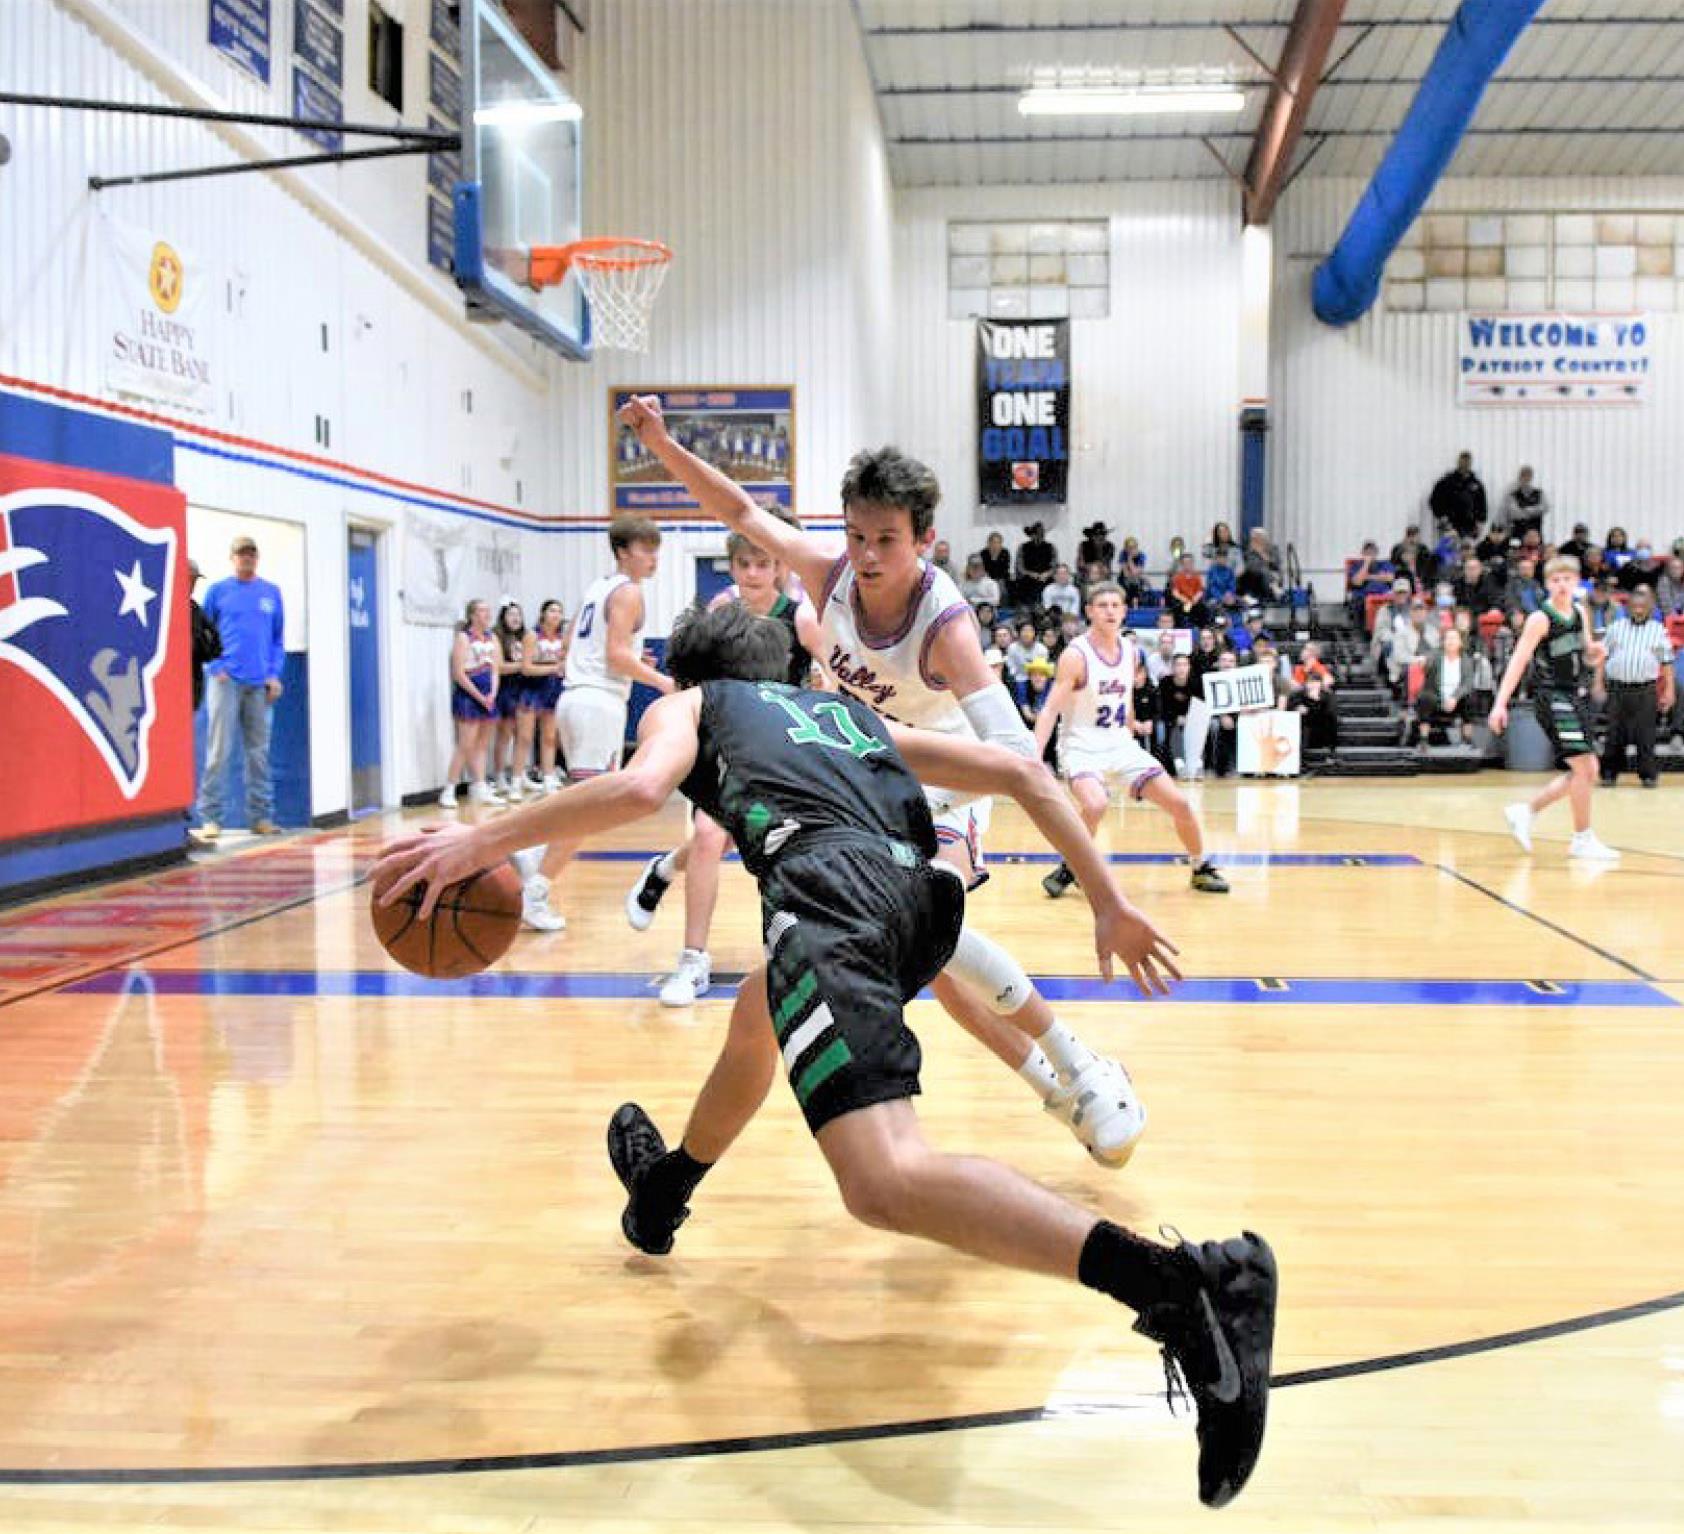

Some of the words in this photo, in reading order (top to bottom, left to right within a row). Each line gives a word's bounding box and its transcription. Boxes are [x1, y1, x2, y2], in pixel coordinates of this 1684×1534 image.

[112, 330, 168, 372] STATE
[992, 325, 1057, 359] ONE
[992, 391, 1057, 427] ONE
[982, 427, 1068, 462] GOAL
[758, 688, 888, 759] 11
[1095, 703, 1126, 729] 24
